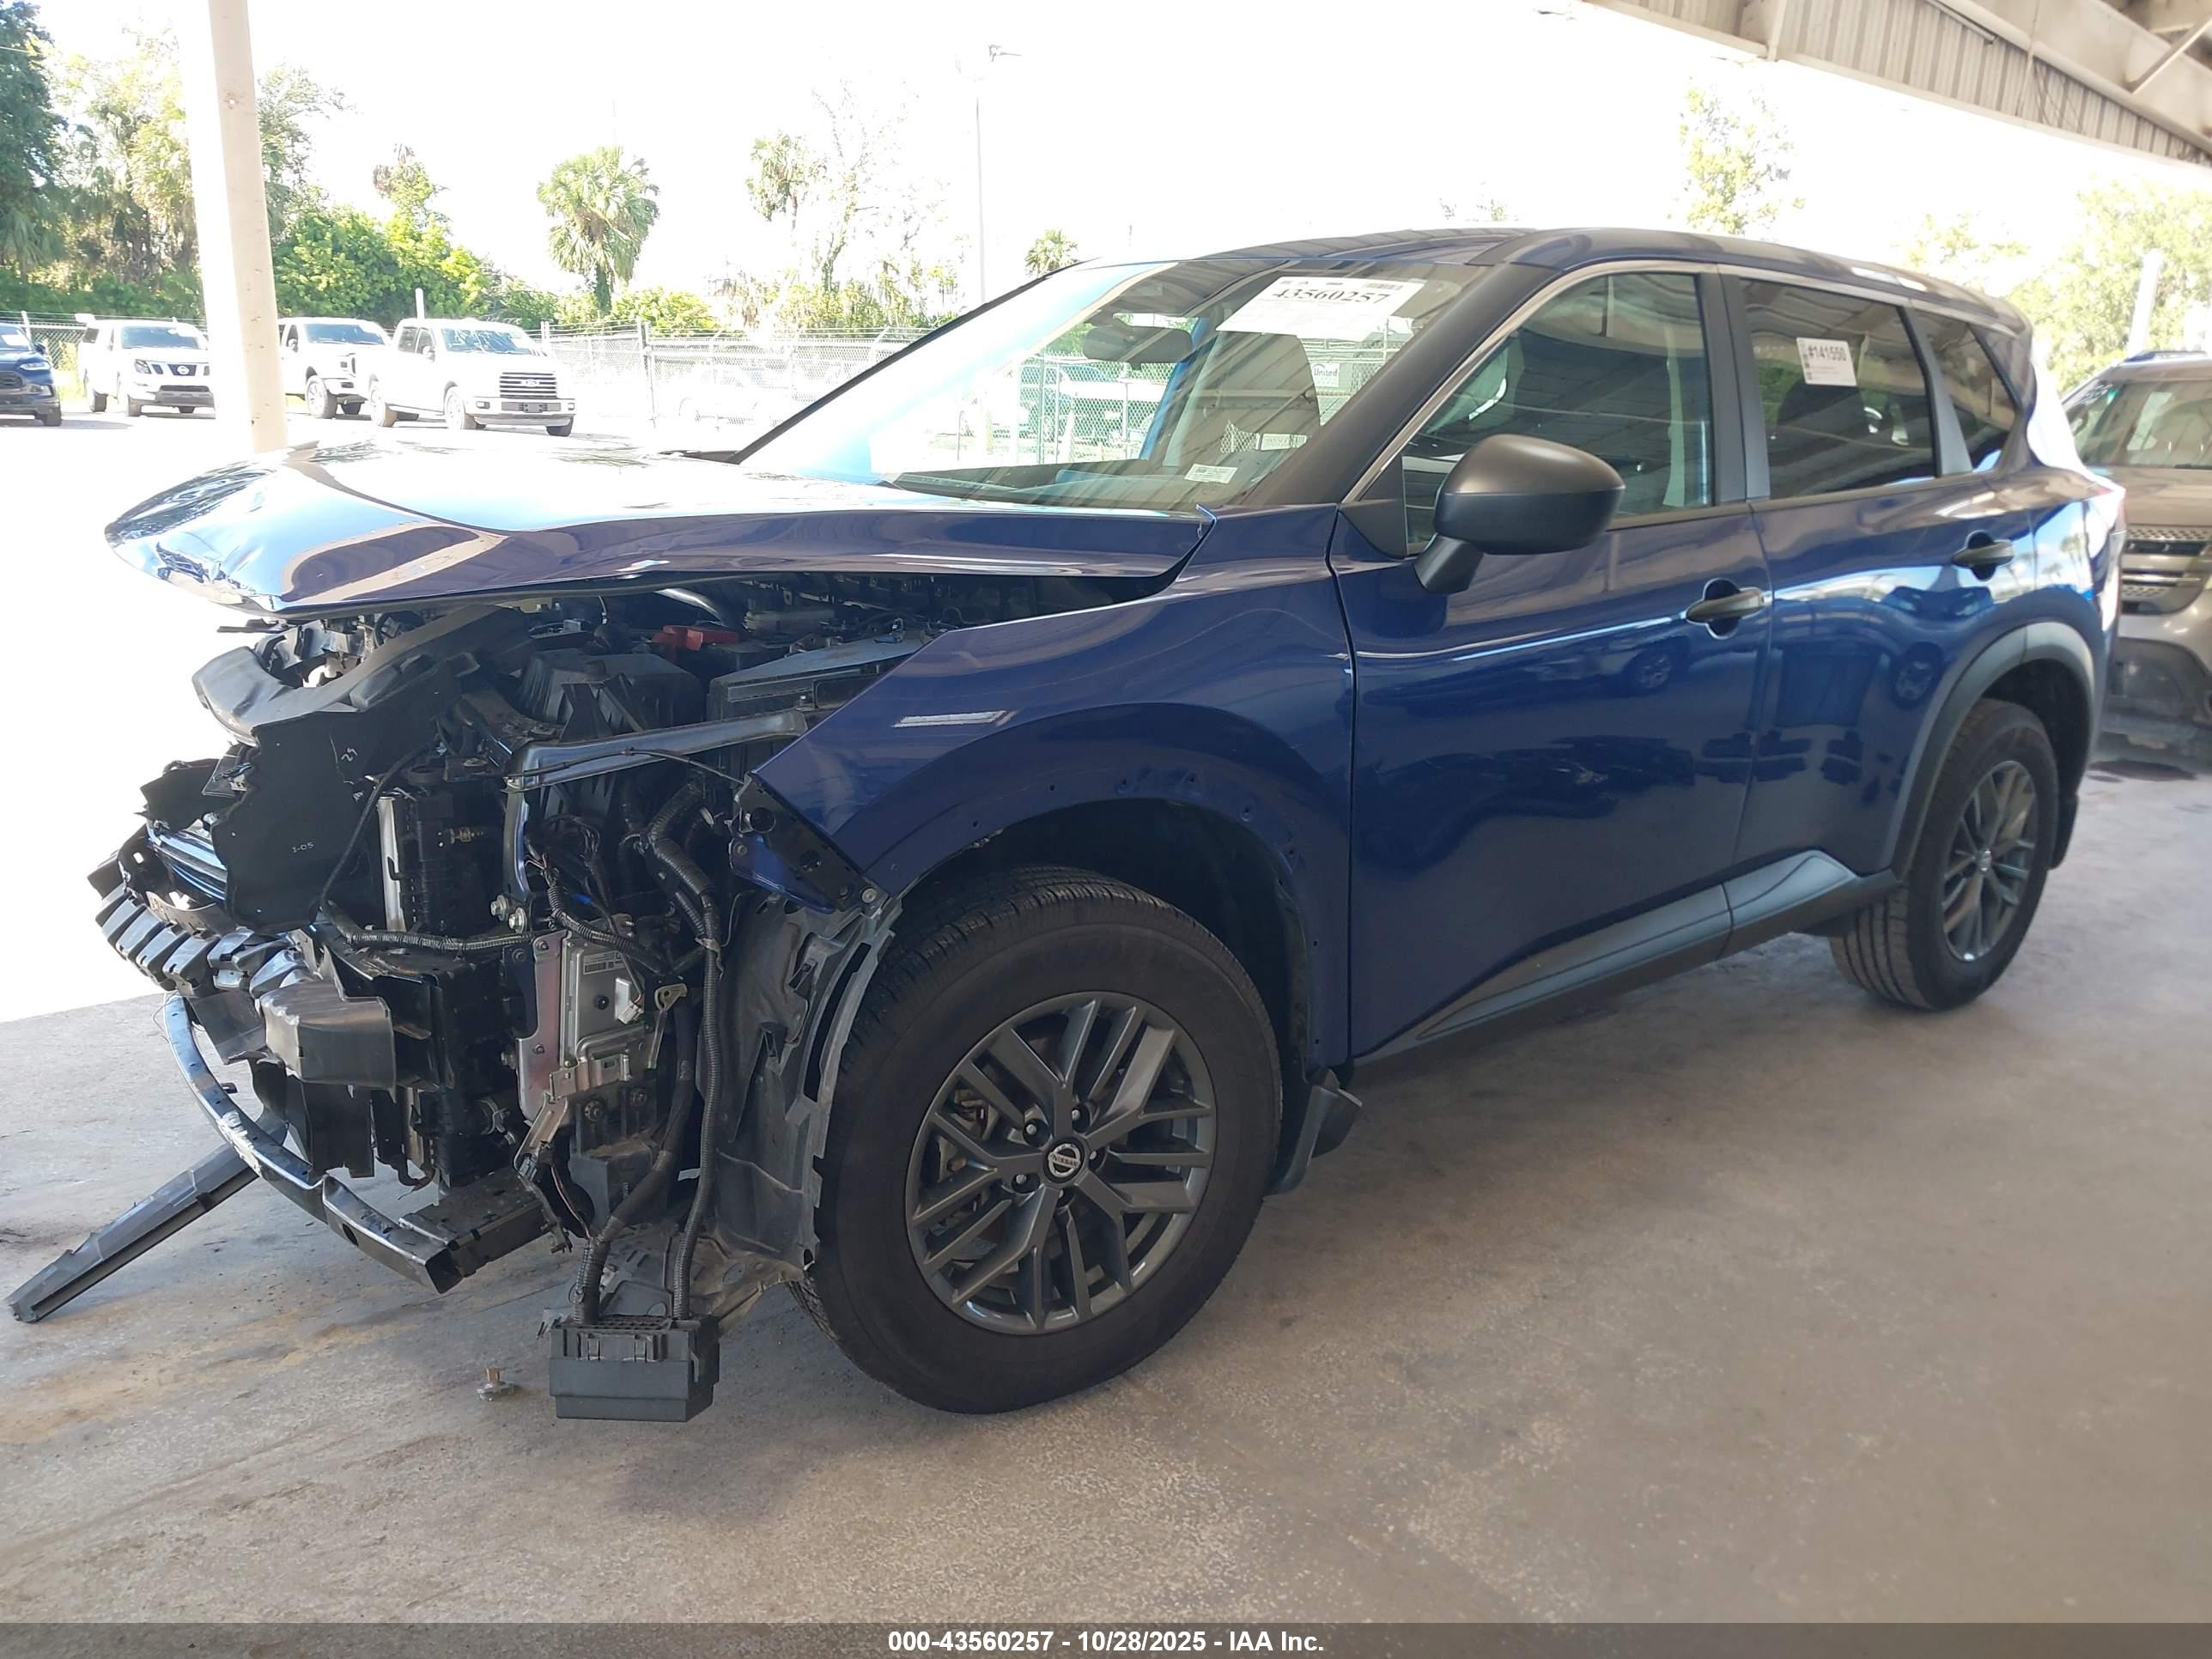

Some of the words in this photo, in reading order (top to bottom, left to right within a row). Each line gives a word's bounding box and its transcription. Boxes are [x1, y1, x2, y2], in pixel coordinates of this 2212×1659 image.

[1273, 289, 1391, 303] 43560257
[1314, 368, 1338, 376] United
[1052, 1153, 1079, 1167] NISSAN
